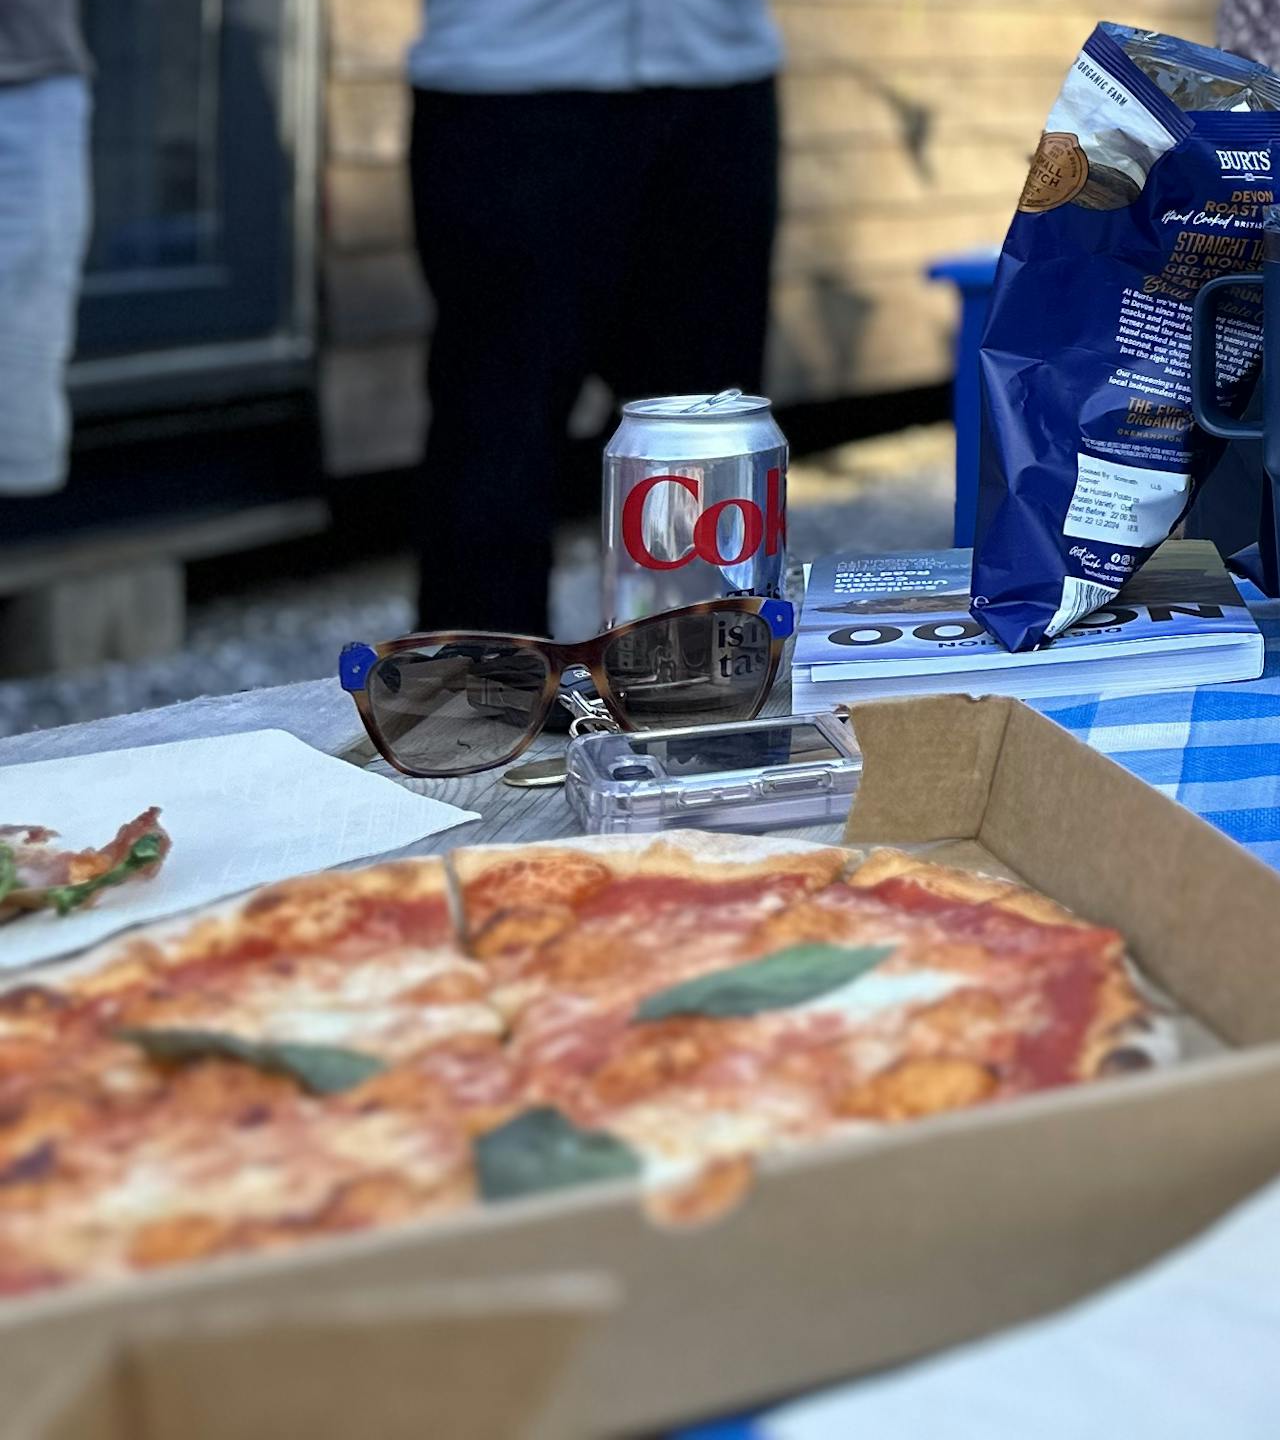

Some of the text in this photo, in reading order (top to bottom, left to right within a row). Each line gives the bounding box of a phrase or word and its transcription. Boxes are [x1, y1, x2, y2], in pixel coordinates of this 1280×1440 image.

[1077, 61, 1129, 107] ORGANIC FARM
[1215, 149, 1271, 171] BURTS
[1231, 189, 1274, 203] DEVON
[1204, 200, 1258, 218] ROAST
[1161, 209, 1264, 230] Hand Cooked BRITIS
[1174, 231, 1250, 258] STRAIGHT
[1169, 252, 1198, 265] NO
[1164, 263, 1223, 280] GREAT
[1131, 300, 1154, 312] Devon
[1144, 324, 1160, 333] and
[1146, 315, 1162, 324] and
[1108, 375, 1128, 387] local
[1129, 381, 1177, 400] independent
[1116, 368, 1131, 378] Our
[1132, 373, 1175, 390] seasonings
[1127, 396, 1152, 414] THE
[1126, 413, 1186, 431] ORGANIC
[622, 467, 787, 571] Cok
[835, 576, 909, 584] Coastal
[880, 569, 931, 577] Road
[834, 579, 949, 589] Unmissable
[834, 585, 937, 594] Scotland's
[717, 620, 745, 648] is
[720, 652, 768, 679] tas
